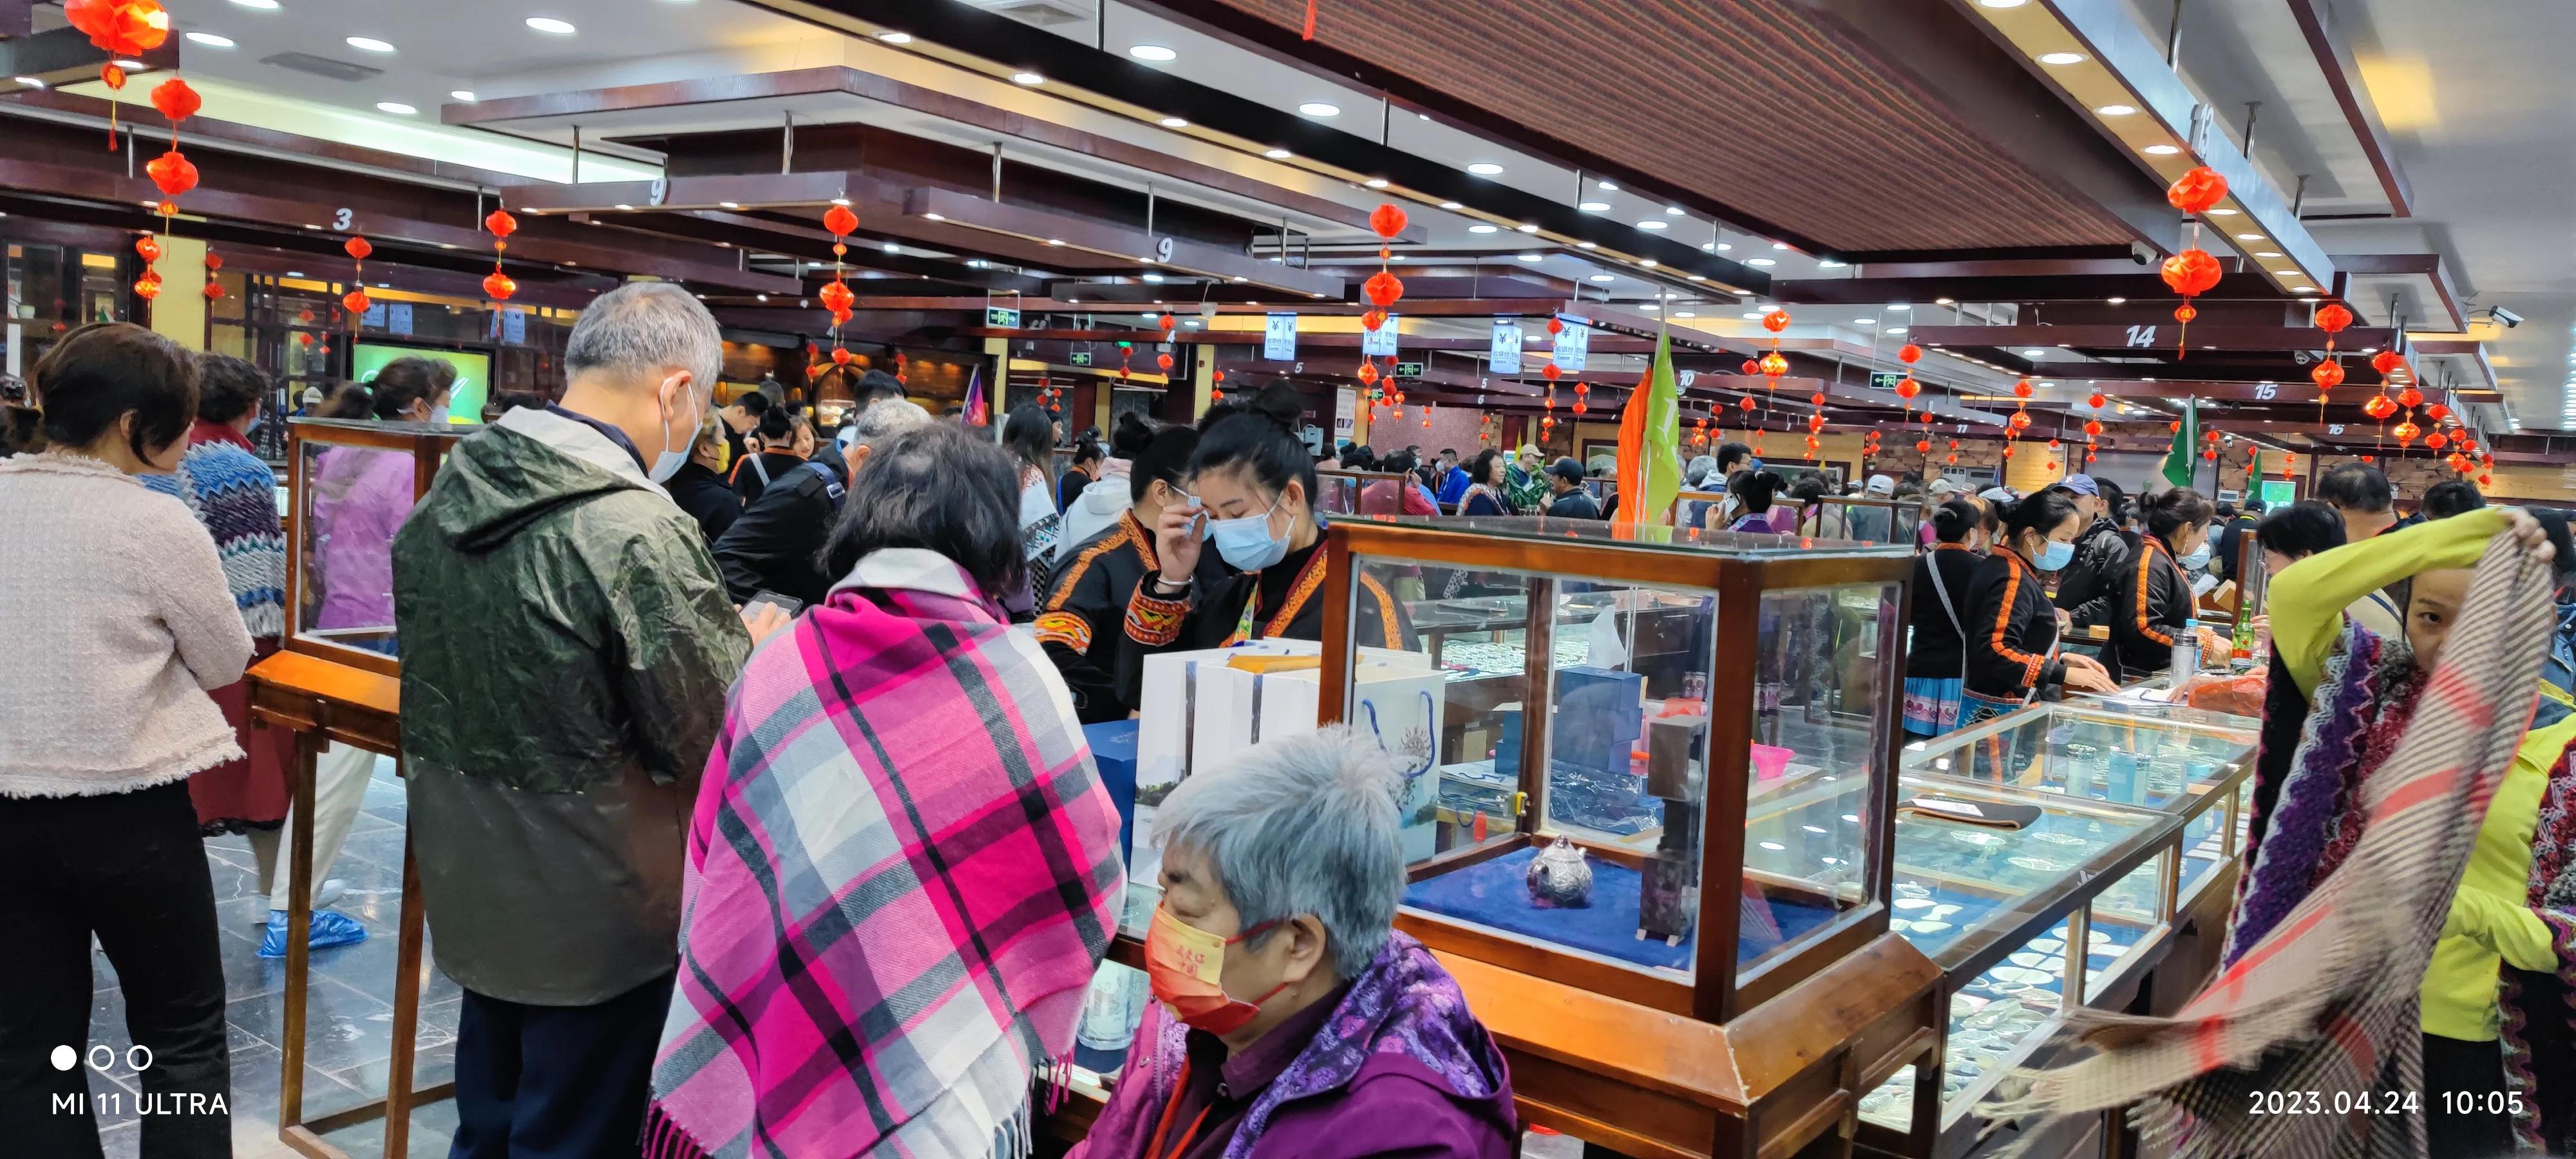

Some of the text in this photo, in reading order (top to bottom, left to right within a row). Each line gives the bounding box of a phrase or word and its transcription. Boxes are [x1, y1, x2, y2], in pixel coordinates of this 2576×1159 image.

[650, 177, 667, 207] 9
[332, 207, 352, 231] 3
[1158, 237, 1173, 263] 9
[2126, 325, 2156, 347] 14
[1294, 362, 1304, 374] 5
[1481, 377, 1489, 389] 5
[1680, 370, 1695, 386] 10
[1477, 394, 1484, 404] 6
[2255, 384, 2278, 400] 15
[2328, 424, 2345, 435] 16
